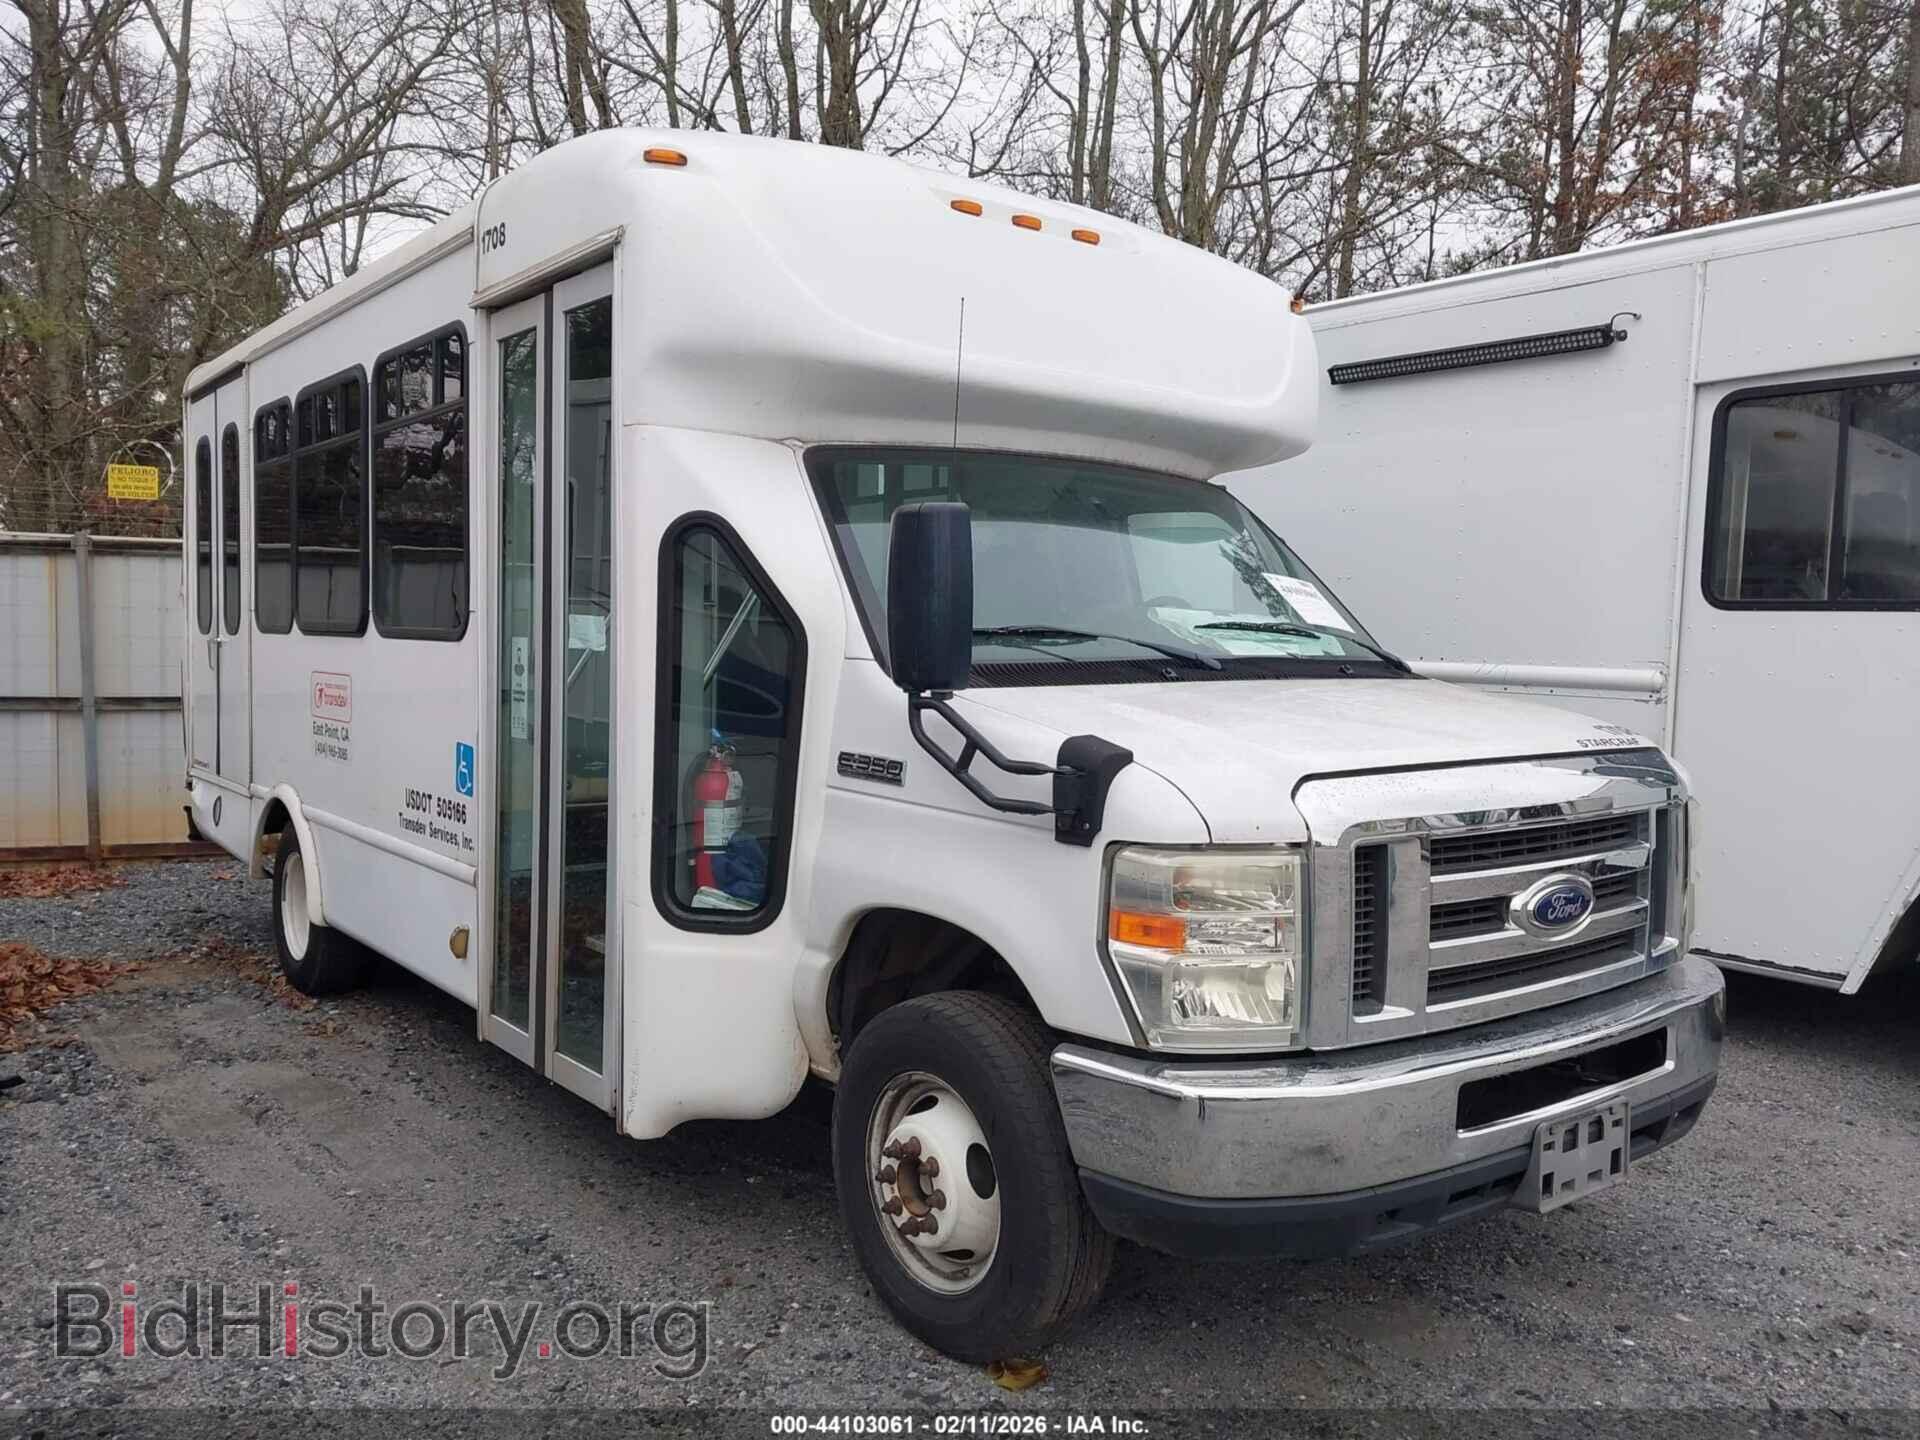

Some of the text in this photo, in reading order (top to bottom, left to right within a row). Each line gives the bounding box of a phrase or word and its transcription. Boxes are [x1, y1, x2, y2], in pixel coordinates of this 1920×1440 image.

[482, 222, 506, 255] 1708
[405, 787, 467, 825] USDOT 505166
[399, 812, 474, 851] Transdev Services, Inc.
[1548, 893, 1583, 920] Ford
